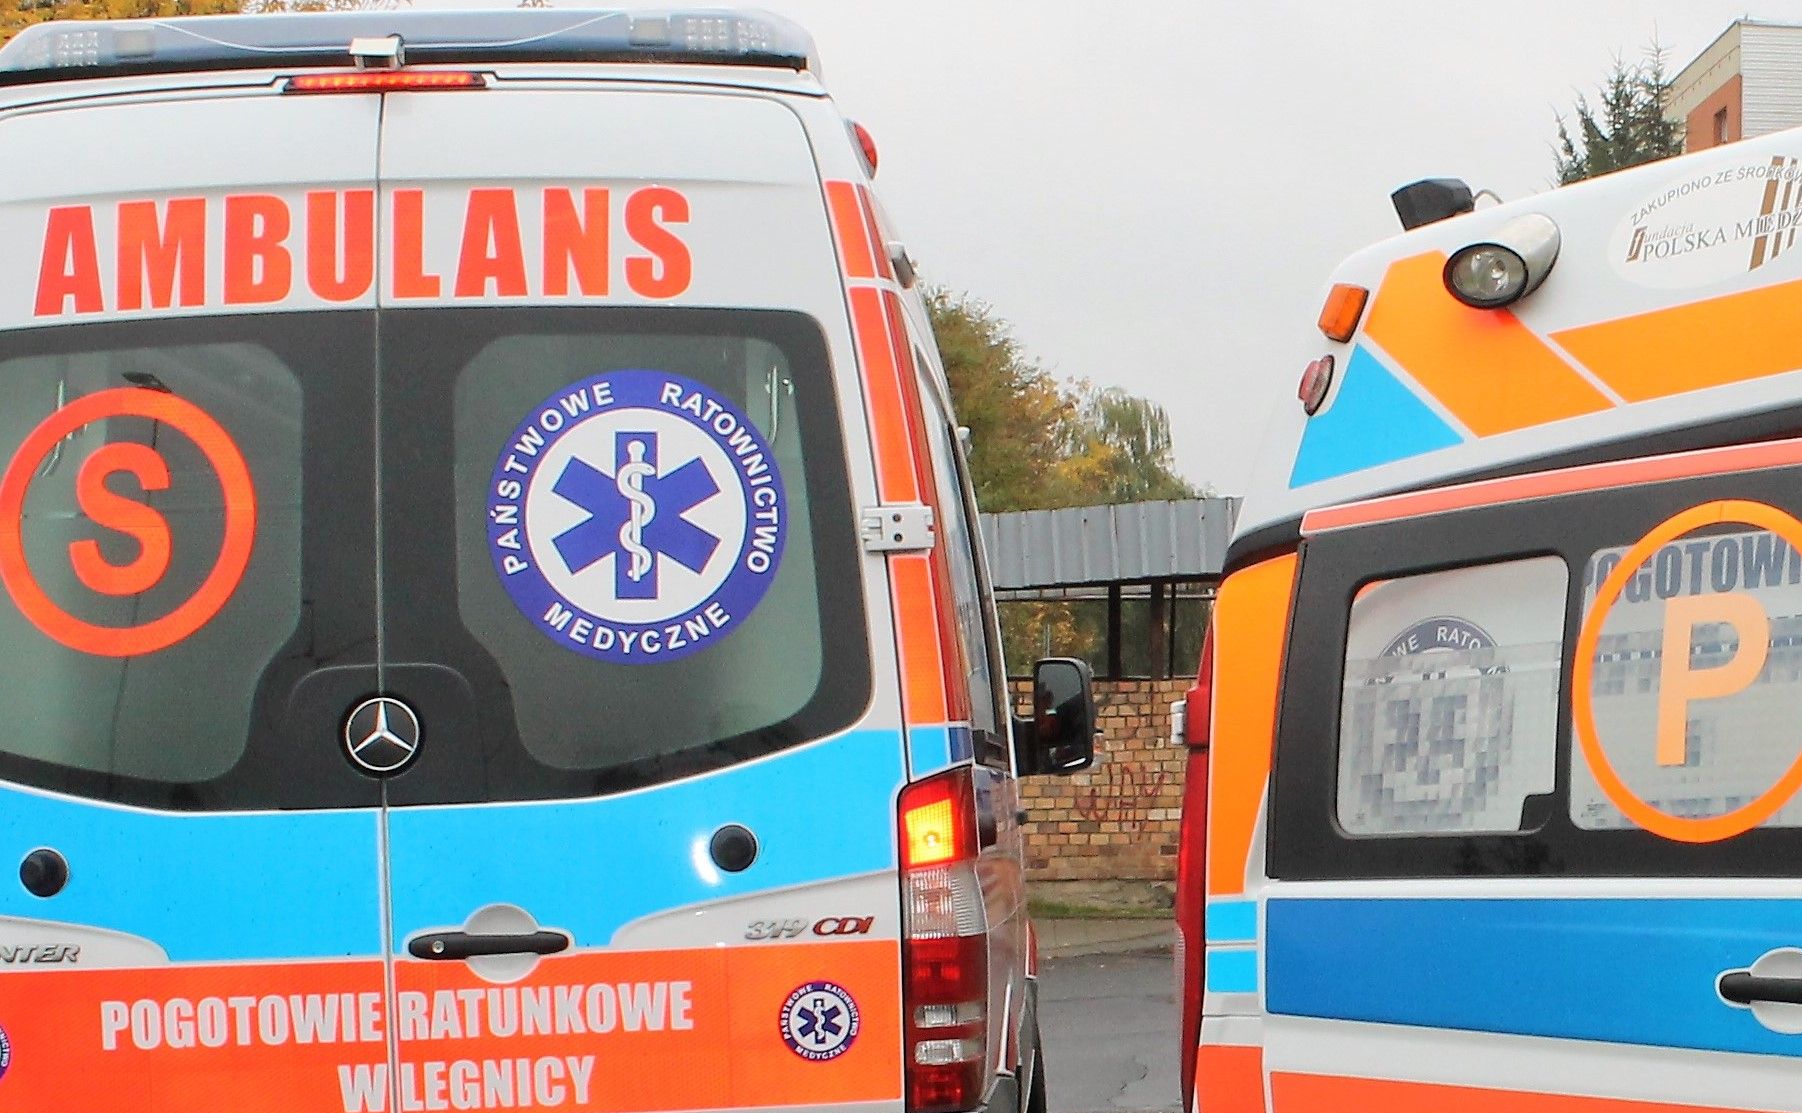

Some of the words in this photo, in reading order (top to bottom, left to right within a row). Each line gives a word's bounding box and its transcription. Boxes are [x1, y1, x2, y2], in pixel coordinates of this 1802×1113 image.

[1630, 175, 1712, 226] ZAKUPIONO
[1714, 169, 1732, 184] ZE
[34, 185, 693, 317] AMBULANS
[1643, 226, 1727, 262] POLSKA
[490, 381, 615, 576] PAŃSTWOWE
[660, 381, 779, 574] RATOWNICTWO
[69, 441, 171, 597] S
[543, 602, 731, 654] MEDYCZNE
[1656, 592, 1771, 767] P
[744, 918, 810, 940] 319
[812, 916, 875, 936] CDI
[101, 991, 382, 1050] POGOTOWIE
[398, 981, 694, 1041] RATUNKOWE
[795, 1044, 847, 1060] MEDYCZNE
[338, 1065, 388, 1113] W
[400, 1055, 595, 1112] LEGNICY
